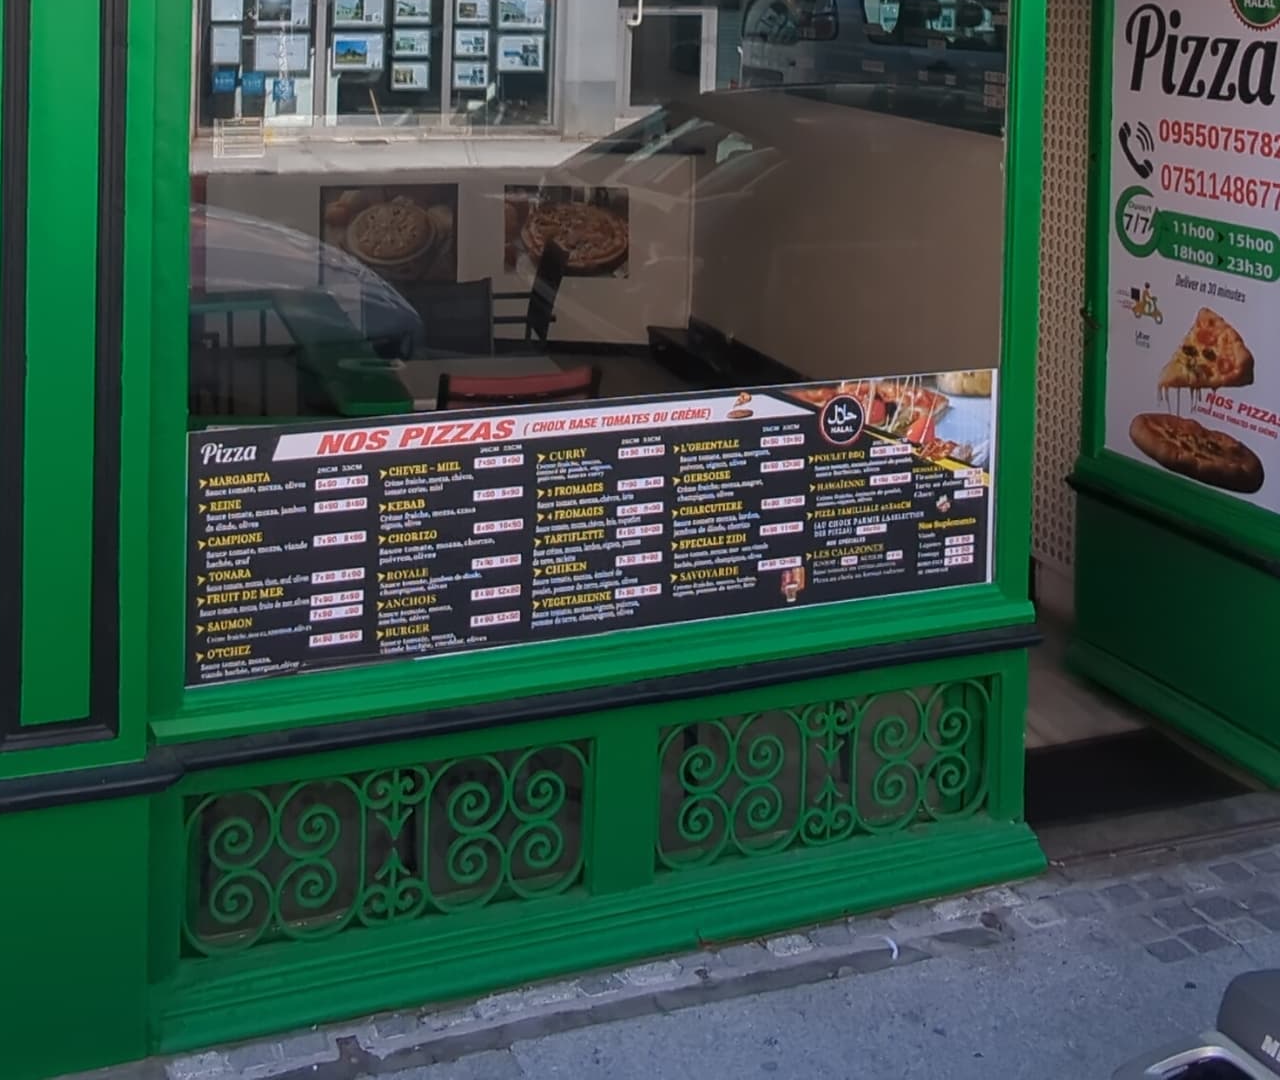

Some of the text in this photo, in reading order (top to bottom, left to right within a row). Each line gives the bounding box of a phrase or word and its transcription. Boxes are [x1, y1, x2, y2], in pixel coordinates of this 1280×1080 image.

[1126, 3, 1278, 106] Pizza
[1124, 212, 1150, 234] 7/7
[1172, 220, 1274, 254] 11h00 15h00
[1172, 244, 1273, 279] 18h00 23h30
[1175, 274, 1246, 303] Deliver in 30 minutes
[1205, 392, 1234, 410] NOS
[317, 429, 390, 455] NOS
[398, 420, 516, 448] PIZZAS
[532, 420, 570, 433] CHOIX
[570, 417, 597, 430] BASE
[601, 413, 650, 427] TOMATES
[652, 411, 668, 422] OU
[830, 425, 854, 434] HALAL
[200, 442, 258, 465] Pizza
[680, 439, 740, 453] L'ORIENTALE
[549, 448, 588, 462] CURRY
[814, 452, 848, 462] POULET
[389, 464, 428, 477] CHEVRE
[437, 461, 461, 472] MIEL
[209, 472, 271, 487] MARGARITA
[683, 470, 731, 484] GERSOISE
[554, 482, 604, 497] FROMAGES
[210, 499, 242, 512] REINE
[388, 499, 426, 512] KEBAB
[554, 506, 604, 520] FROMAGES
[680, 501, 742, 516] CHARCUTIERE
[814, 508, 835, 518] PIZZA
[207, 532, 264, 548] CAMPIONE
[388, 530, 438, 544] CHORIZO
[544, 529, 605, 544] TARTIFLETTE
[678, 534, 747, 550] SPECIALE ZIDI
[208, 569, 252, 582] TONARA
[386, 568, 429, 582] ROYALE
[545, 562, 588, 576] CHIKEN
[680, 566, 739, 581] SAVOYARDE
[207, 586, 284, 604] FRUIT DE MER
[385, 594, 438, 610] ANCHOIS
[542, 591, 612, 608] VEGETARIENNE
[207, 618, 252, 632] SAUMON
[385, 624, 430, 638] BURGER
